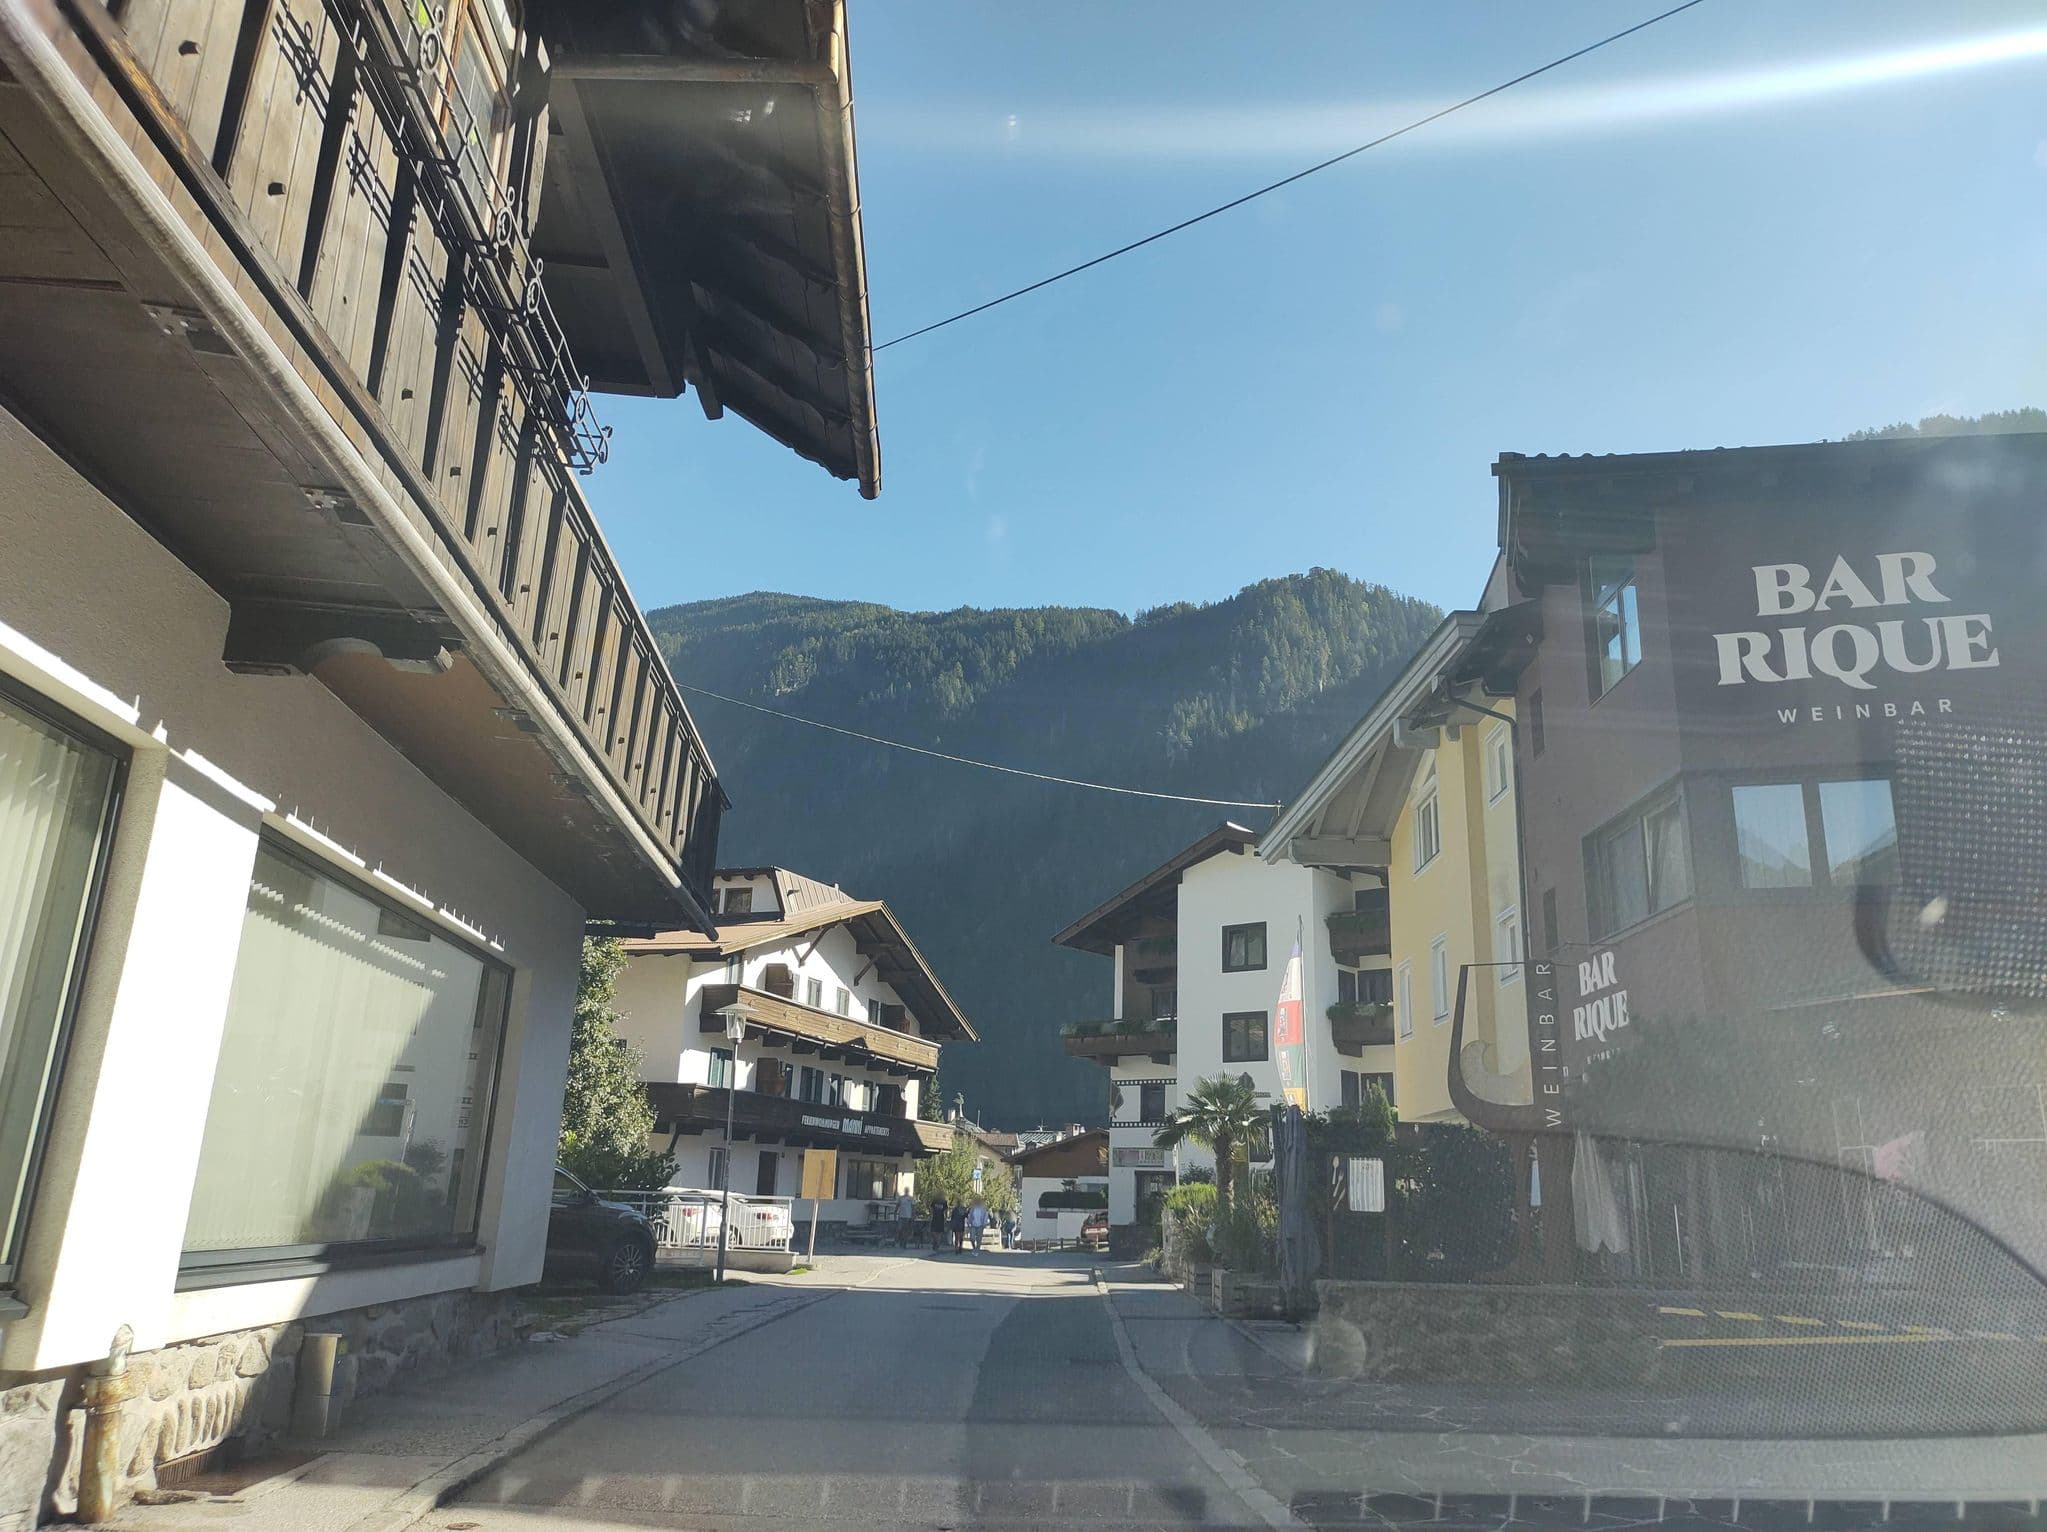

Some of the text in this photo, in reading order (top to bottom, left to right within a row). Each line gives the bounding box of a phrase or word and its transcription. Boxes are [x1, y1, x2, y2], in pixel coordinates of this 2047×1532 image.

[1752, 551, 1953, 617] BAR
[1711, 613, 2000, 690] RIQUE
[1777, 698, 1953, 724] WEINBAR
[1578, 951, 1618, 997] BAR
[1535, 963, 1562, 1127] WEINBAR
[1573, 990, 1629, 1042] RIQUE
